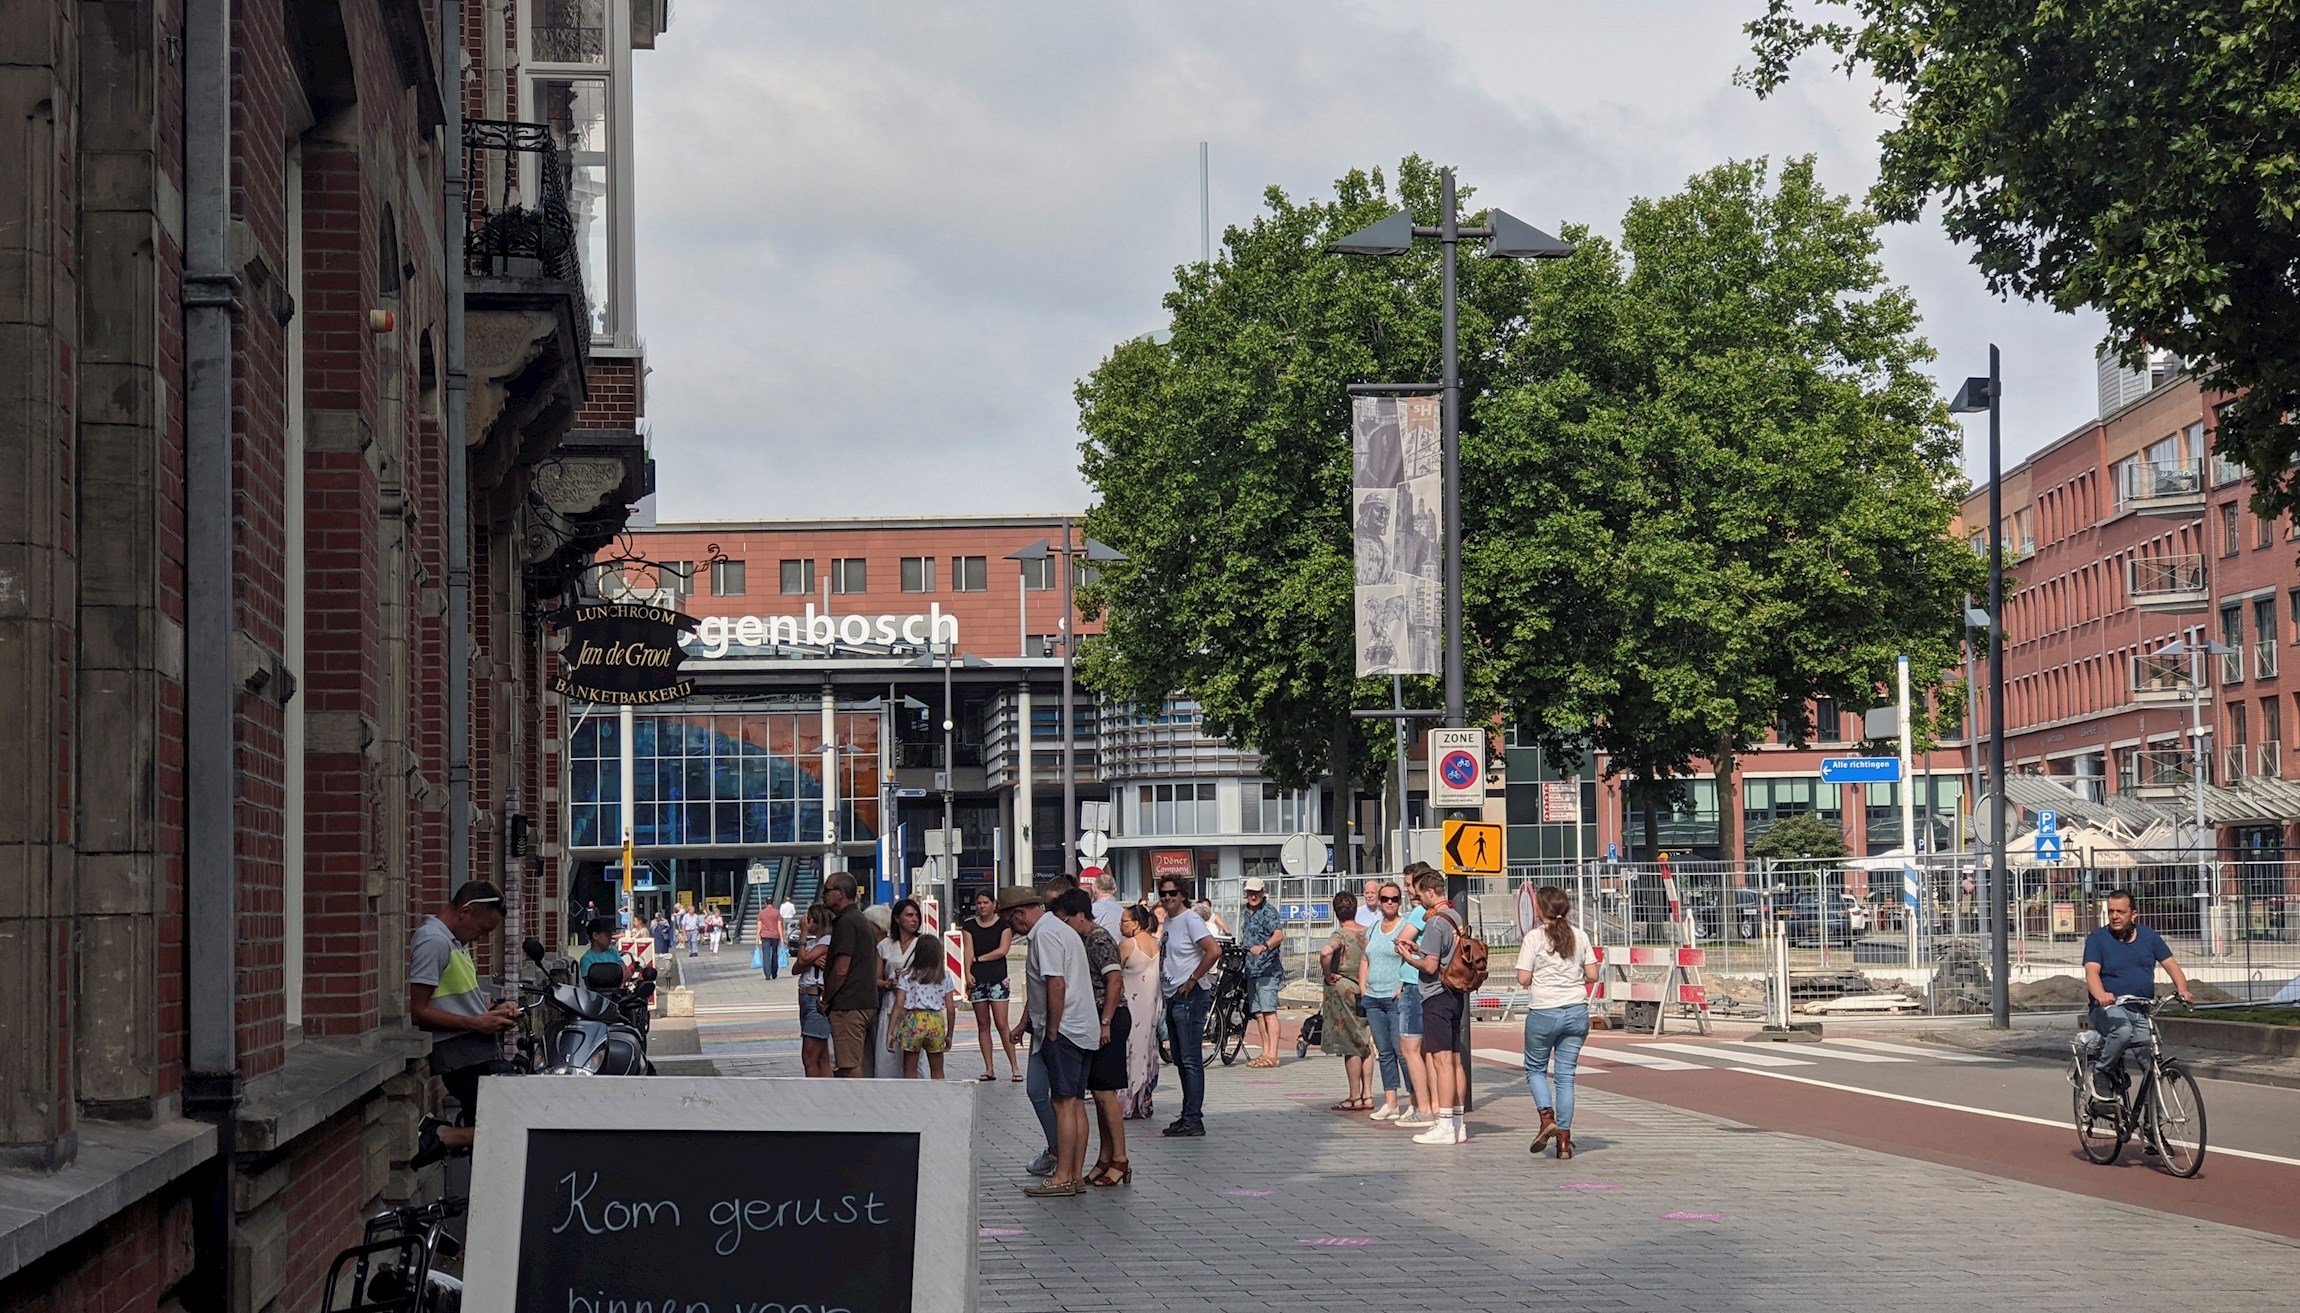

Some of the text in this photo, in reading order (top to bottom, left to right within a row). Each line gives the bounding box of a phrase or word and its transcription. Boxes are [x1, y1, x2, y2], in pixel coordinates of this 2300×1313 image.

[576, 605, 677, 625] LUNCHROOM
[572, 640, 672, 670] Jan de Groot
[555, 678, 692, 704] BANKETBAKKERIJ
[1444, 733, 1475, 743] ZONE
[1849, 761, 1890, 770] richtingen
[1163, 856, 1187, 865] Döner
[1156, 866, 1189, 874] Company
[552, 1171, 890, 1256] Kom gerust
